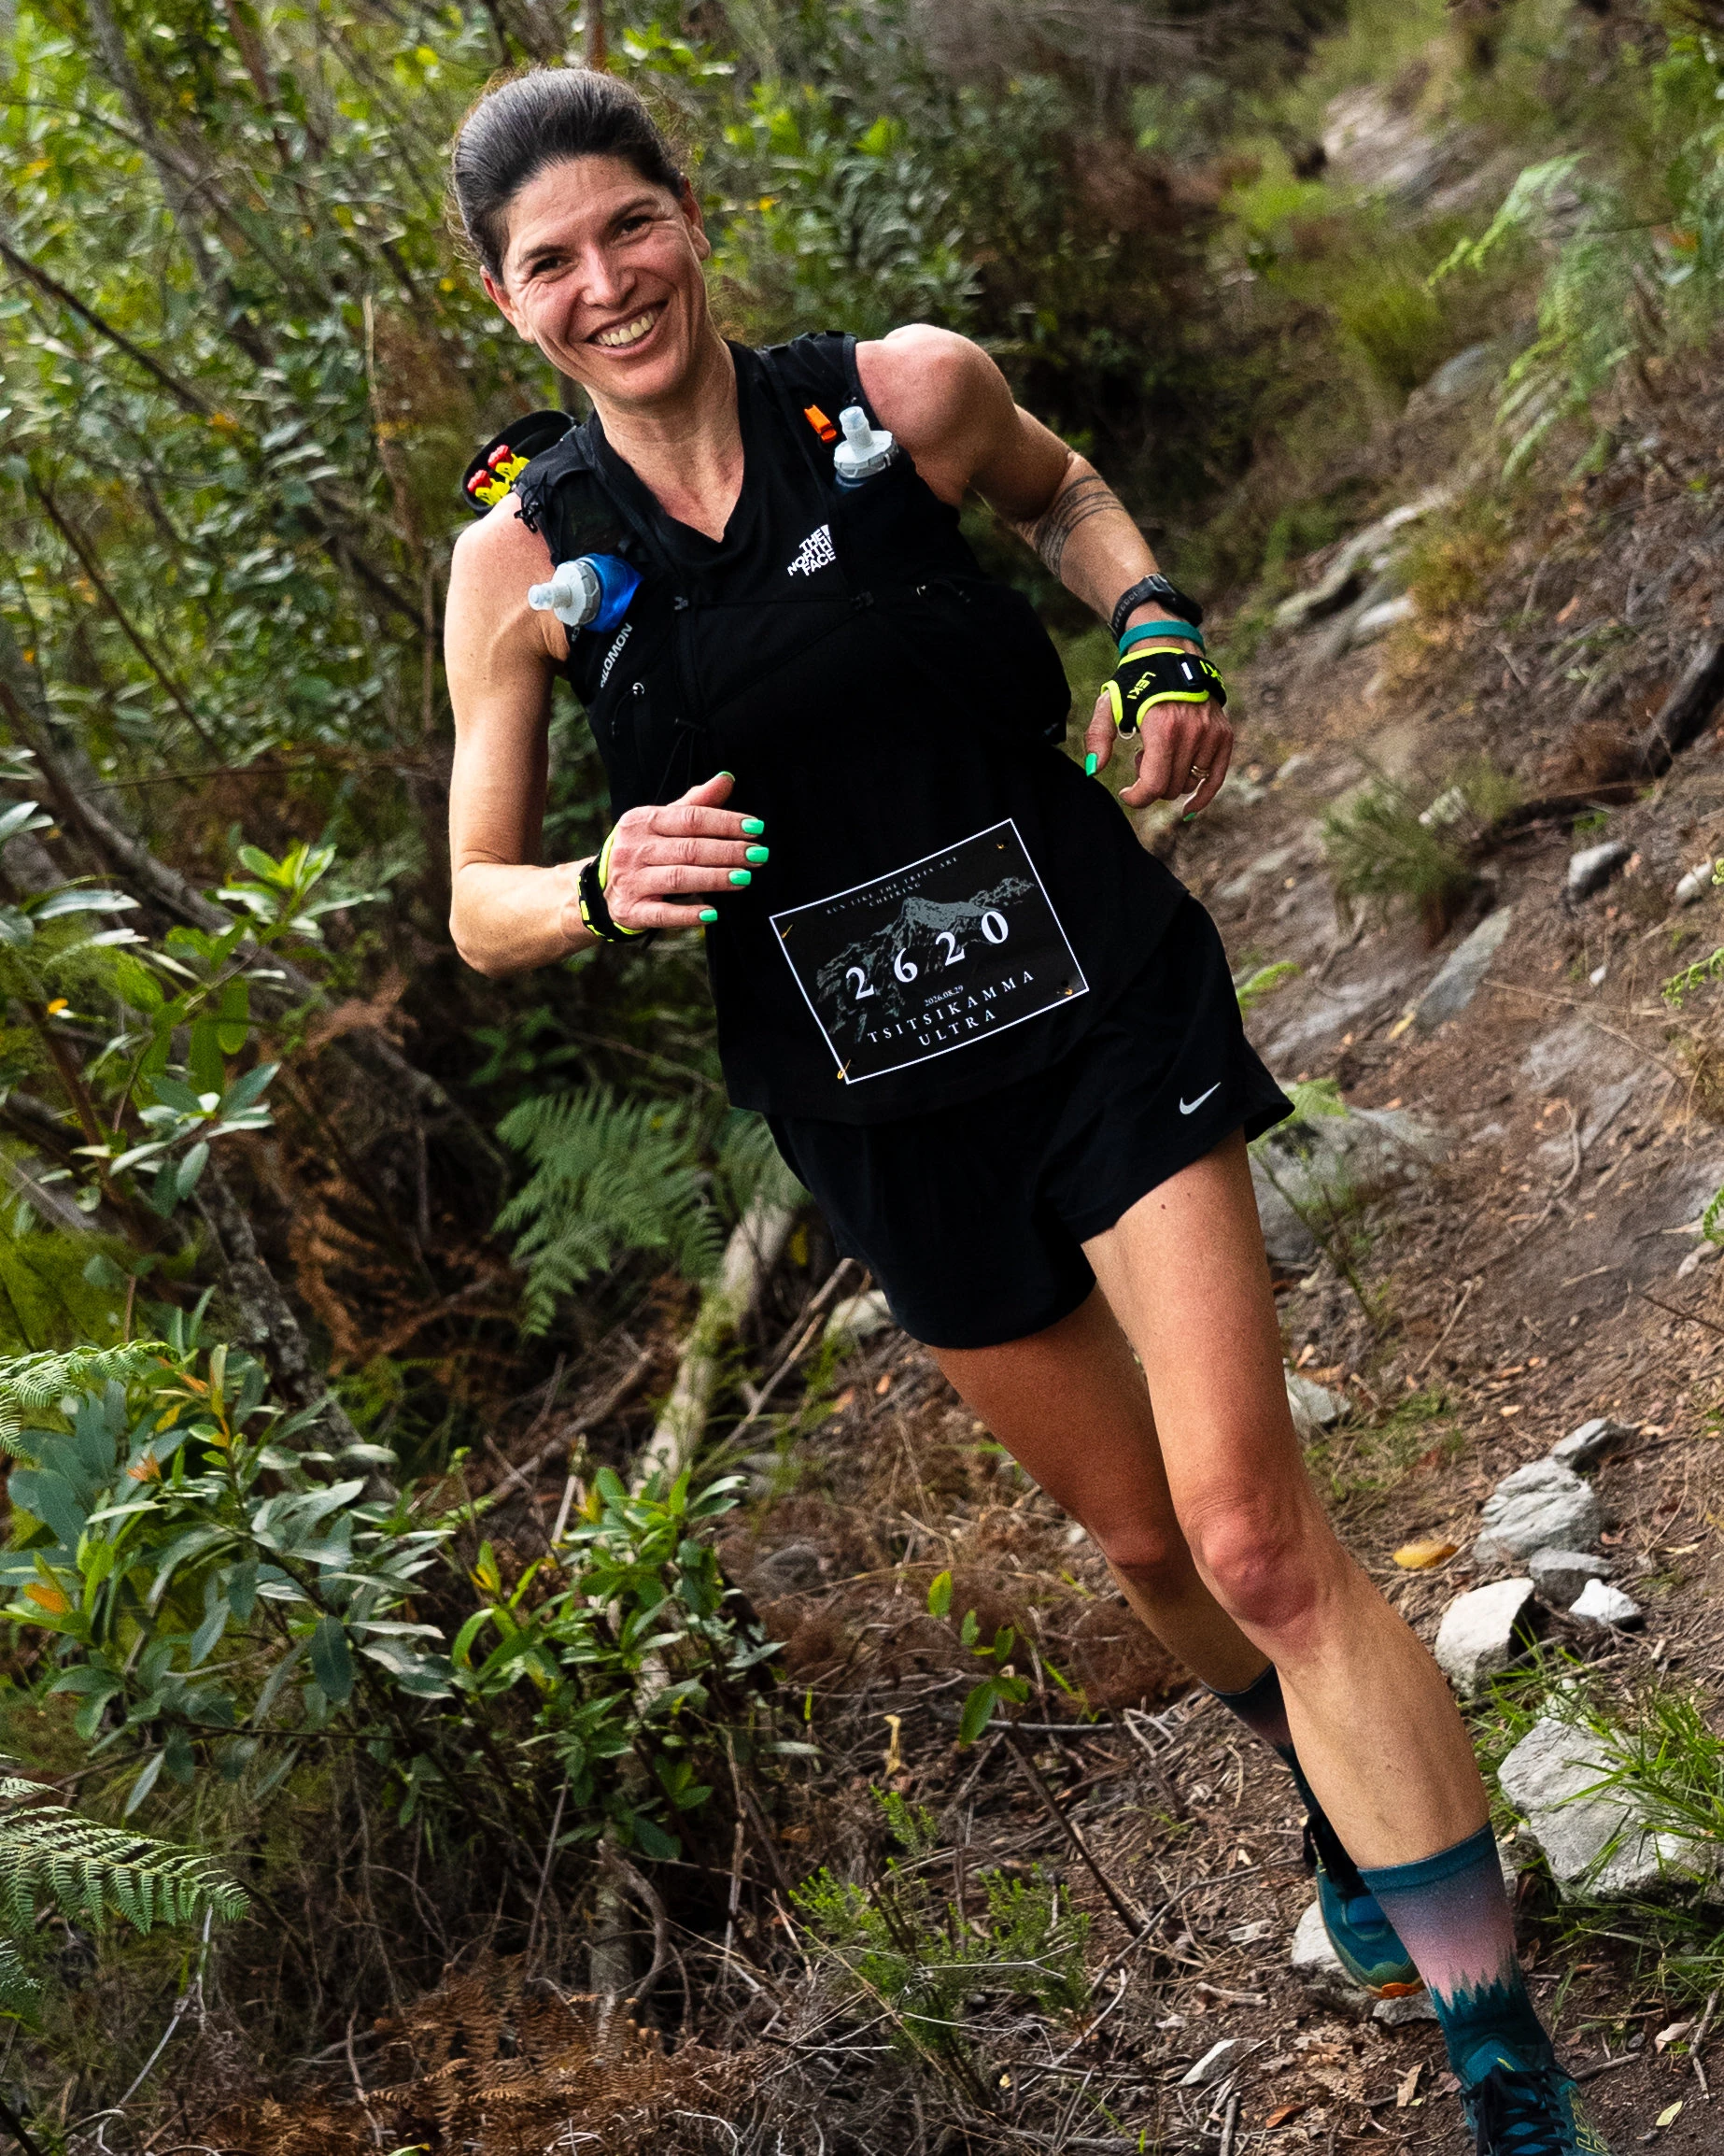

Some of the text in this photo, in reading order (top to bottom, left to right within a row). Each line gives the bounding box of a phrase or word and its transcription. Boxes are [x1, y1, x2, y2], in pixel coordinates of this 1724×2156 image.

[787, 535, 833, 575] NORTH
[798, 529, 826, 553] THE
[802, 548, 836, 575] FACE
[1126, 671, 1156, 700] LEKI
[867, 971, 1034, 1043] TSITSIKAMMA
[923, 985, 964, 1007] 2026.08.29
[918, 1009, 996, 1046] ULTRA
